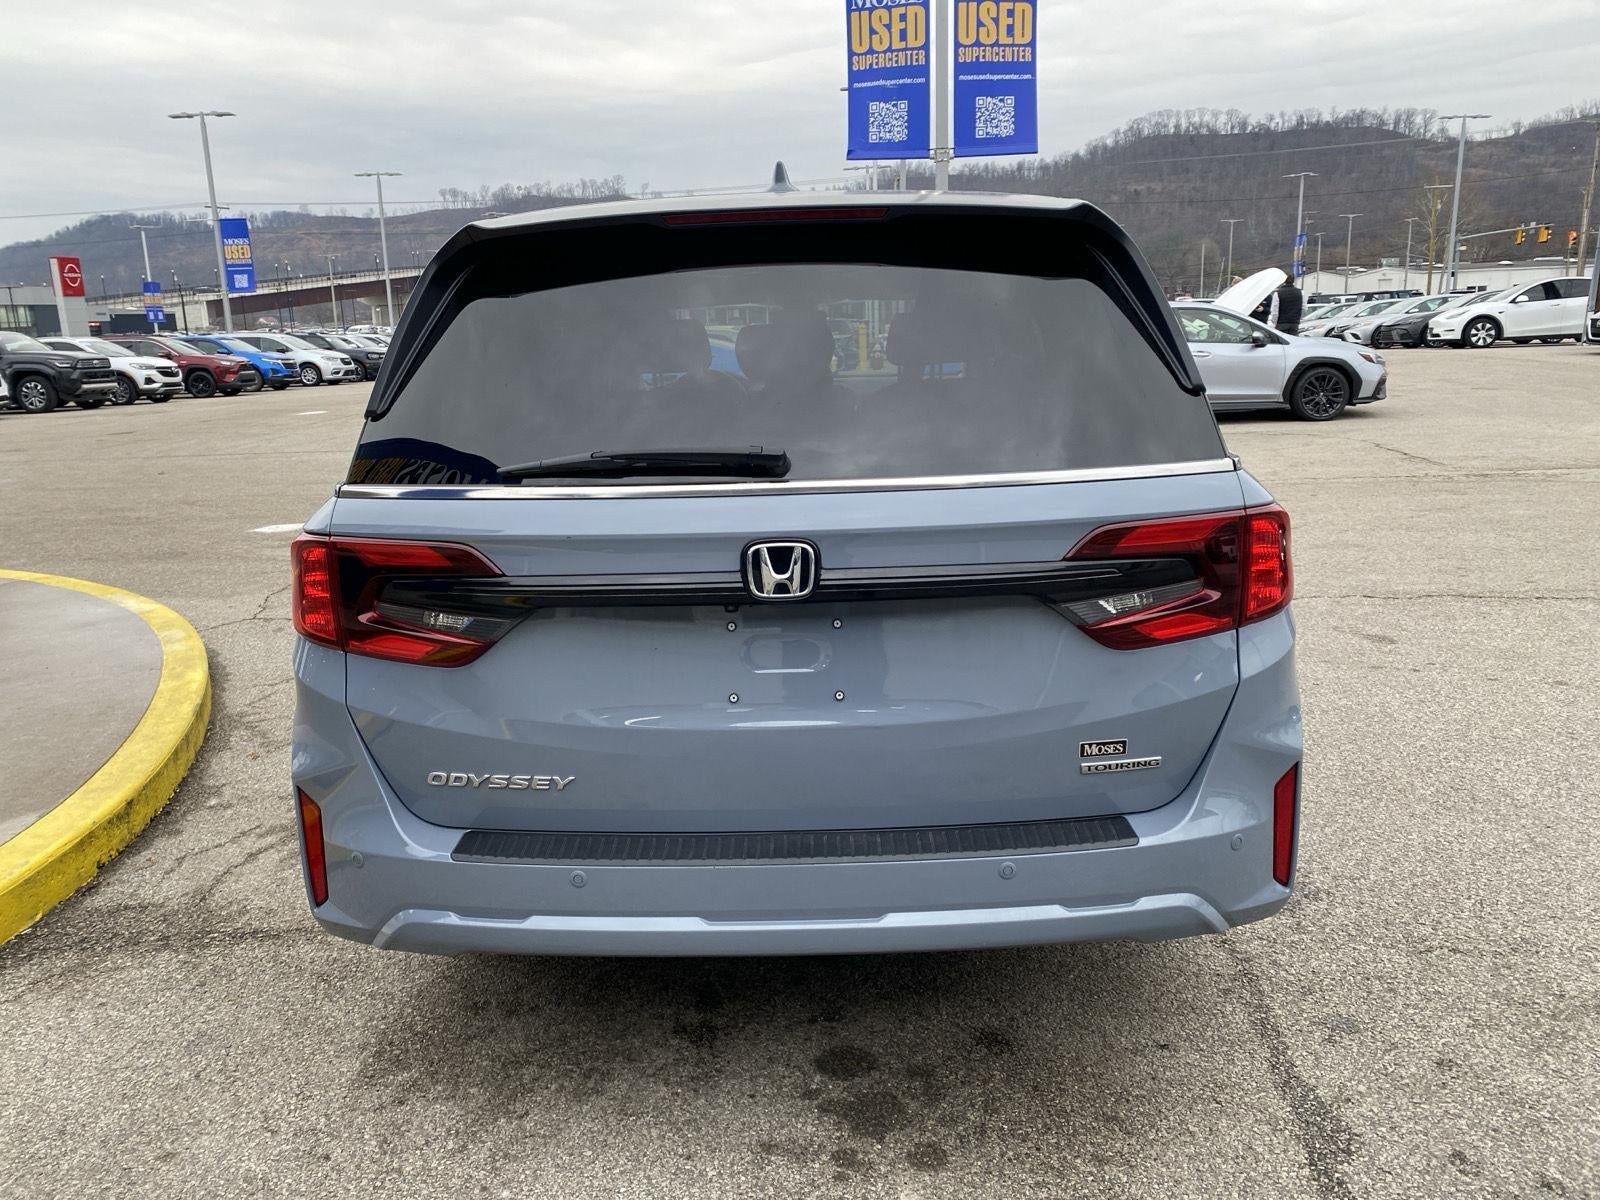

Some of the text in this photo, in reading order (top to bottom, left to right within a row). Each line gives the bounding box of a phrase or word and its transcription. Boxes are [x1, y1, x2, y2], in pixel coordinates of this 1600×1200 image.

[850, 5, 926, 54] USED
[957, 1, 1033, 46] USED
[852, 50, 926, 71] SUPERCENTER
[958, 47, 1032, 63] SUPERCENTER
[853, 77, 926, 88] mosesusedsupercenter.com
[959, 73, 1032, 82] mosesusedsupercenter.com
[223, 238, 250, 246] MOSES
[224, 244, 251, 259] USED
[1084, 759, 1160, 772] TOURING
[427, 771, 576, 790] ODYSSEY
